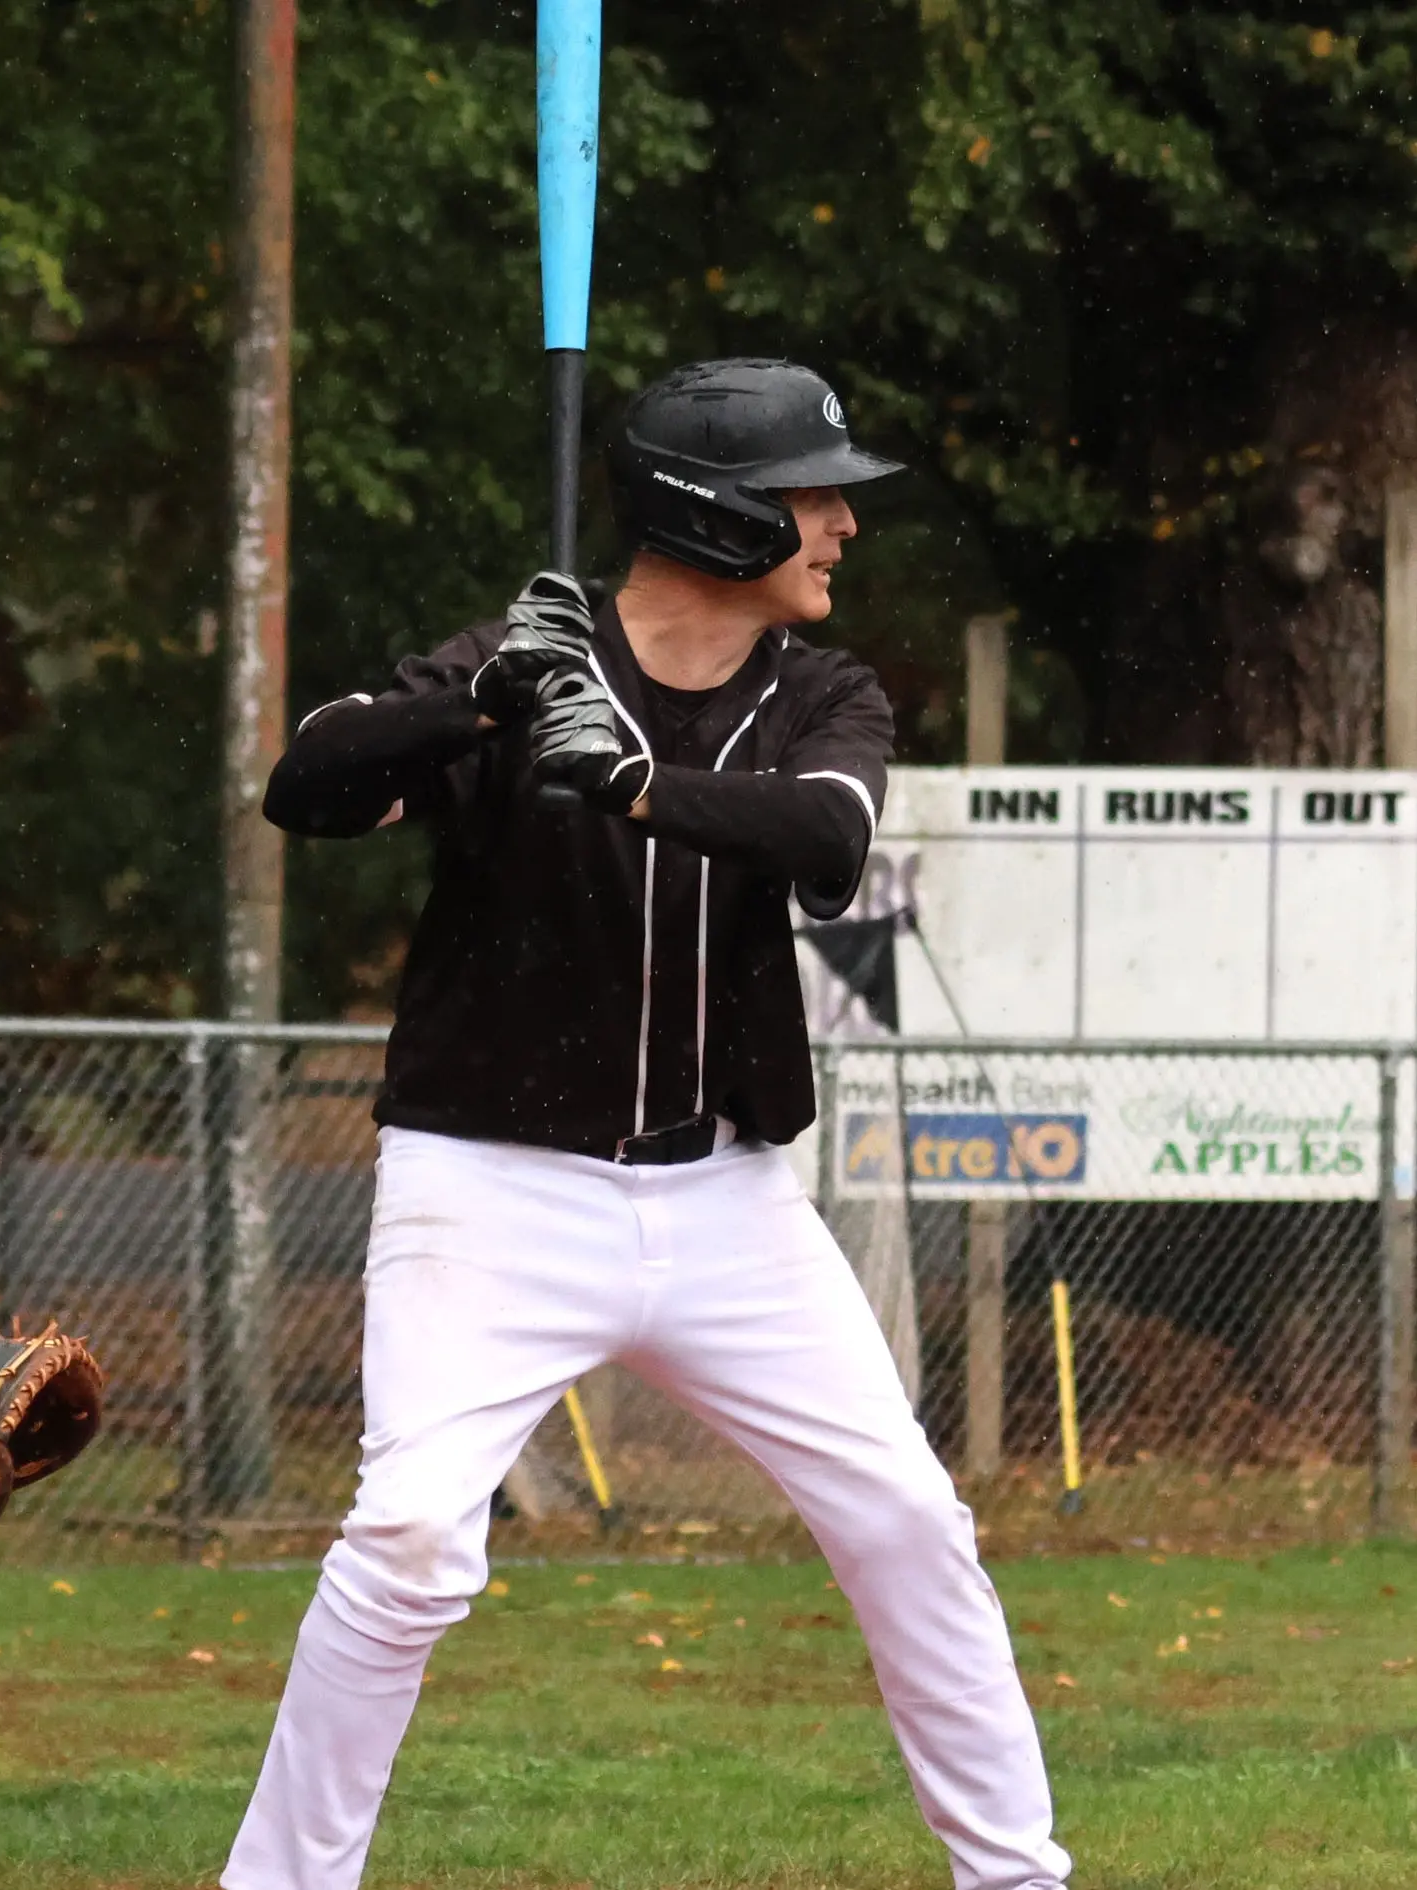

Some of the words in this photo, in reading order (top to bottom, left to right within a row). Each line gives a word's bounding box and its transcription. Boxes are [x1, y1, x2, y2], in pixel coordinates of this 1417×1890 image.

[653, 470, 717, 500] RAWLINGS
[969, 788, 1060, 823] INN
[1105, 789, 1250, 824] RUNS
[1303, 790, 1405, 824] OUT
[1151, 1140, 1364, 1175] APPLES
